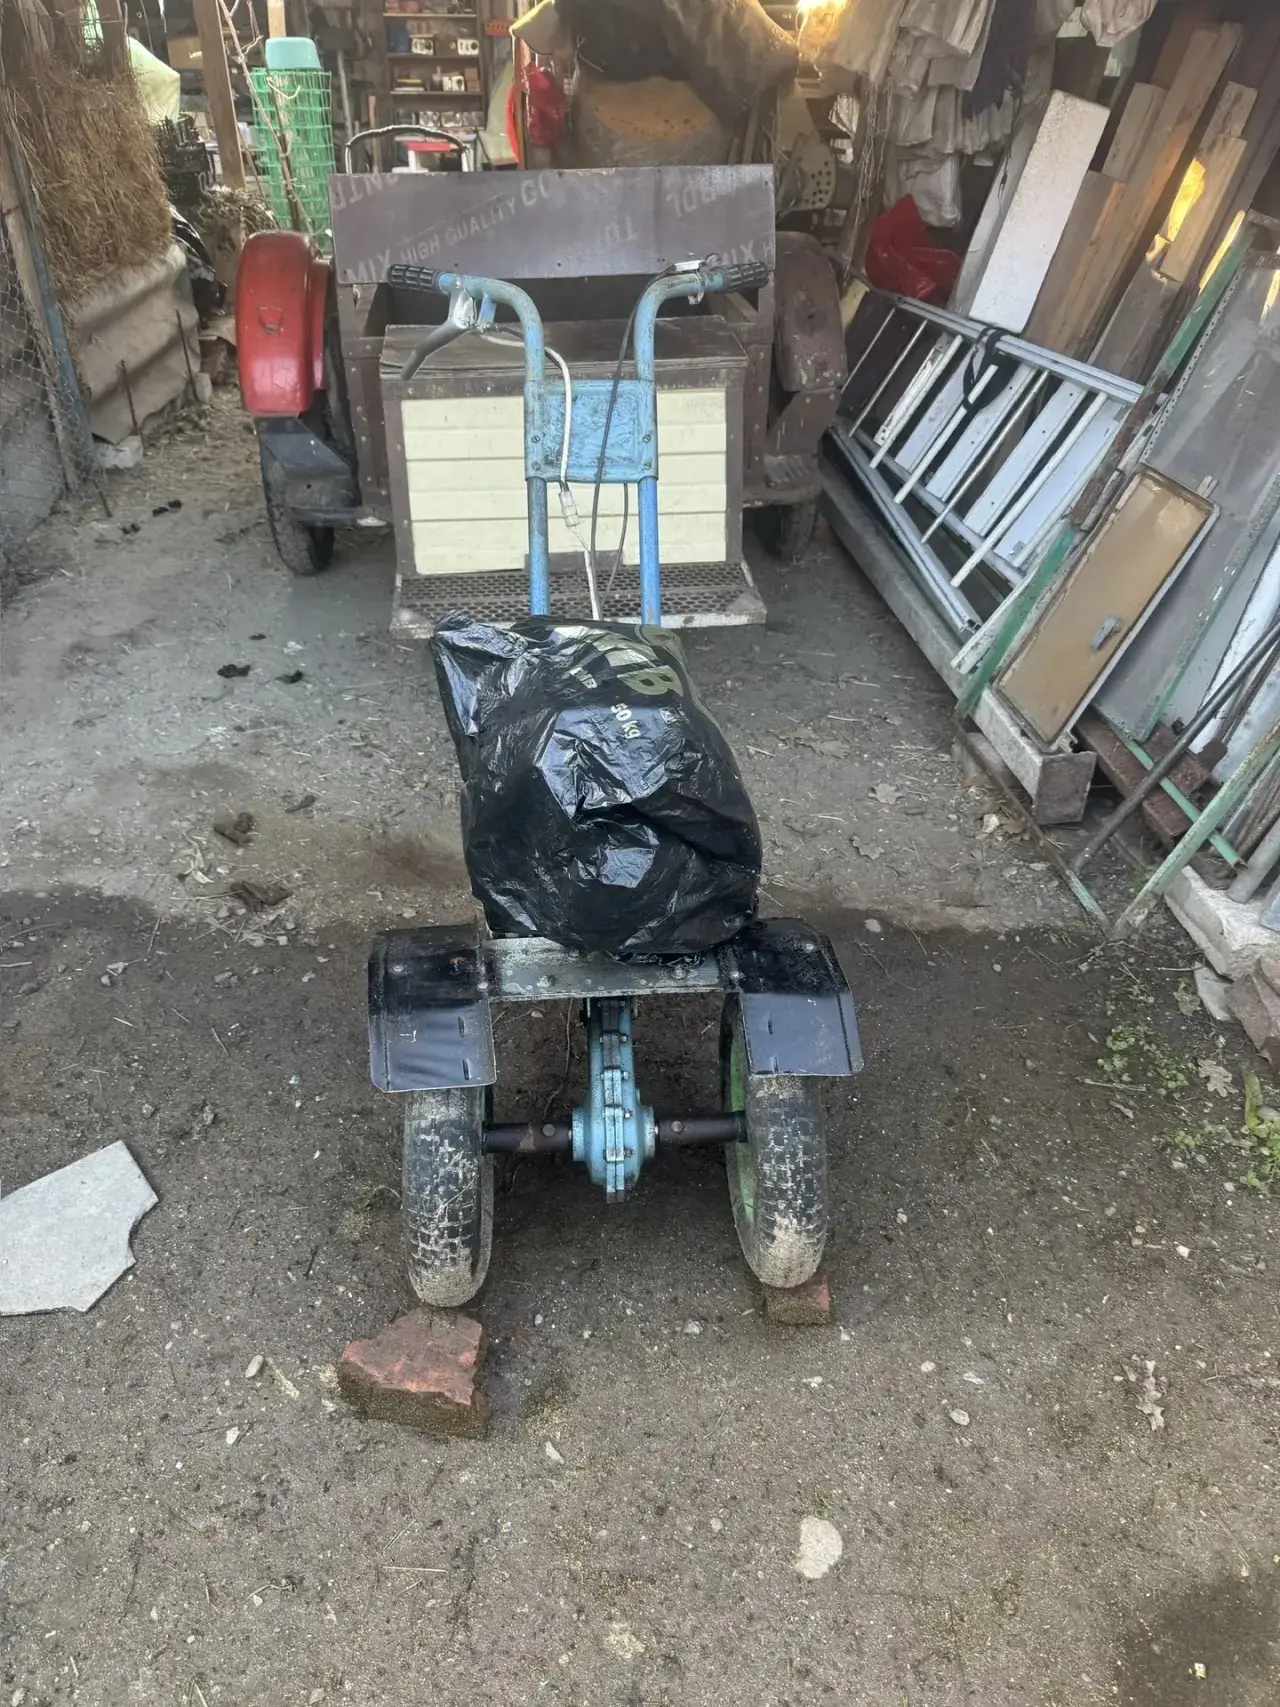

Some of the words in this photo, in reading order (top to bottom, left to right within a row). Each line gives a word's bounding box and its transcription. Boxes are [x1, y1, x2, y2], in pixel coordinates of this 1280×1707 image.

[400, 233, 440, 265] HIGH
[611, 703, 632, 721] 50
[620, 720, 641, 739] kg
